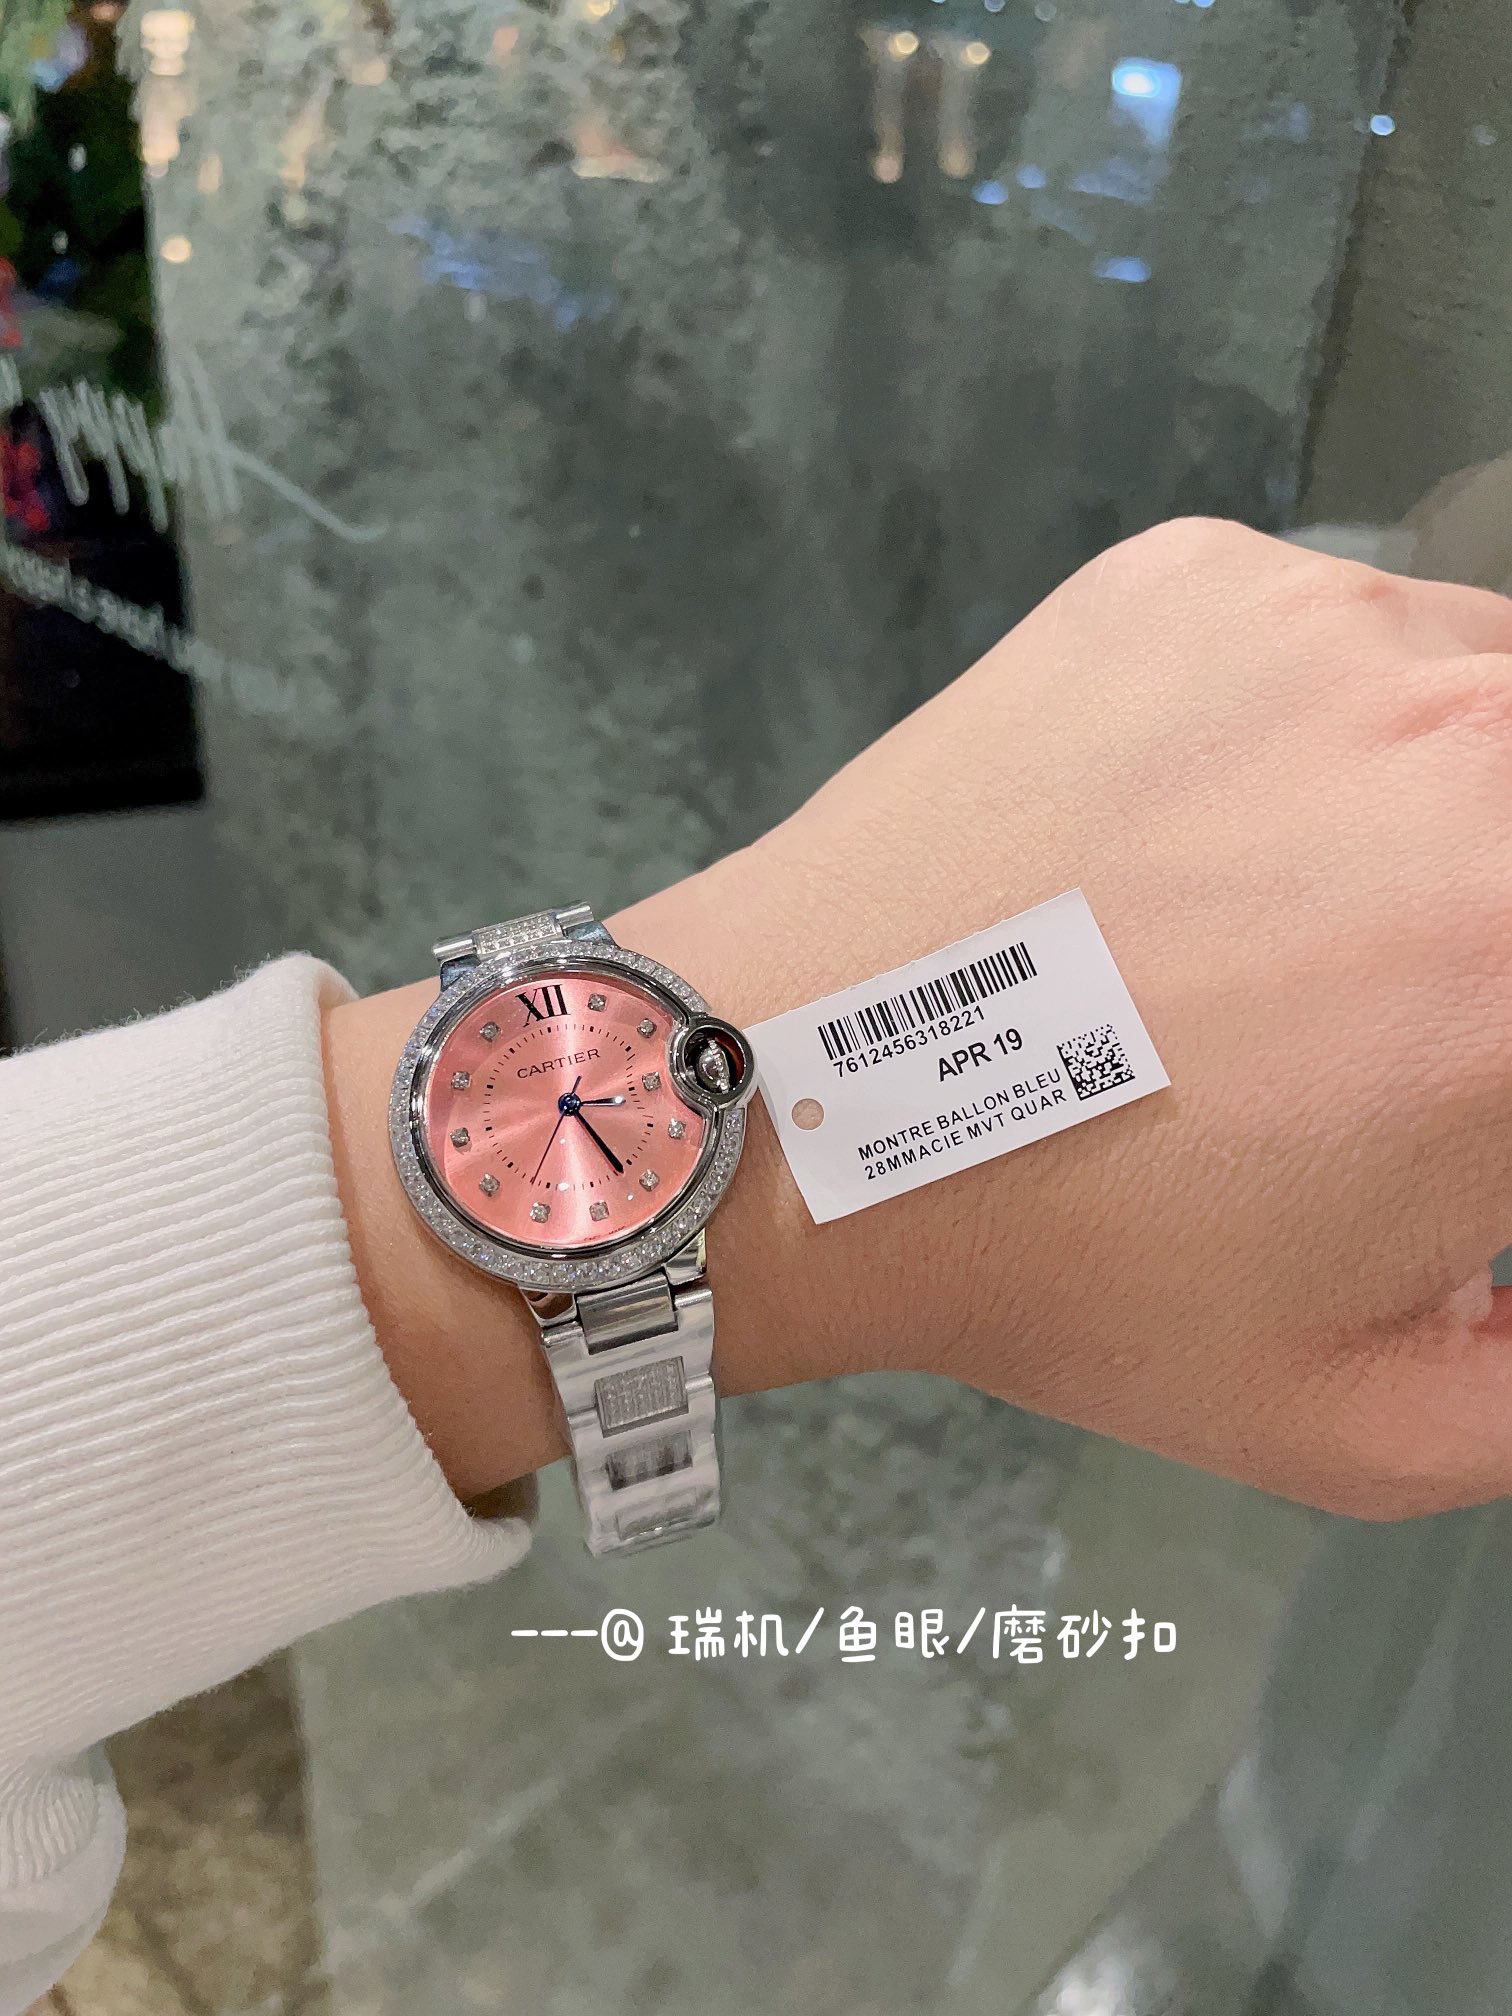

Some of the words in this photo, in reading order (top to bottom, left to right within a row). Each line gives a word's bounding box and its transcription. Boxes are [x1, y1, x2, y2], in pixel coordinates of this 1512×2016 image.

[515, 984, 571, 1028] XII
[517, 1048, 600, 1079] CARTIER
[833, 1006, 986, 1078] 7612456318221
[937, 1041, 992, 1082] APR
[993, 1028, 1023, 1056] 19
[857, 1120, 934, 1161] MONTRE
[936, 1090, 1011, 1130] BALLON
[1012, 1068, 1062, 1099] BLEU
[864, 1131, 964, 1181] 28MMACIE
[966, 1113, 1006, 1140] MVT
[1010, 1088, 1067, 1121] QUAR
